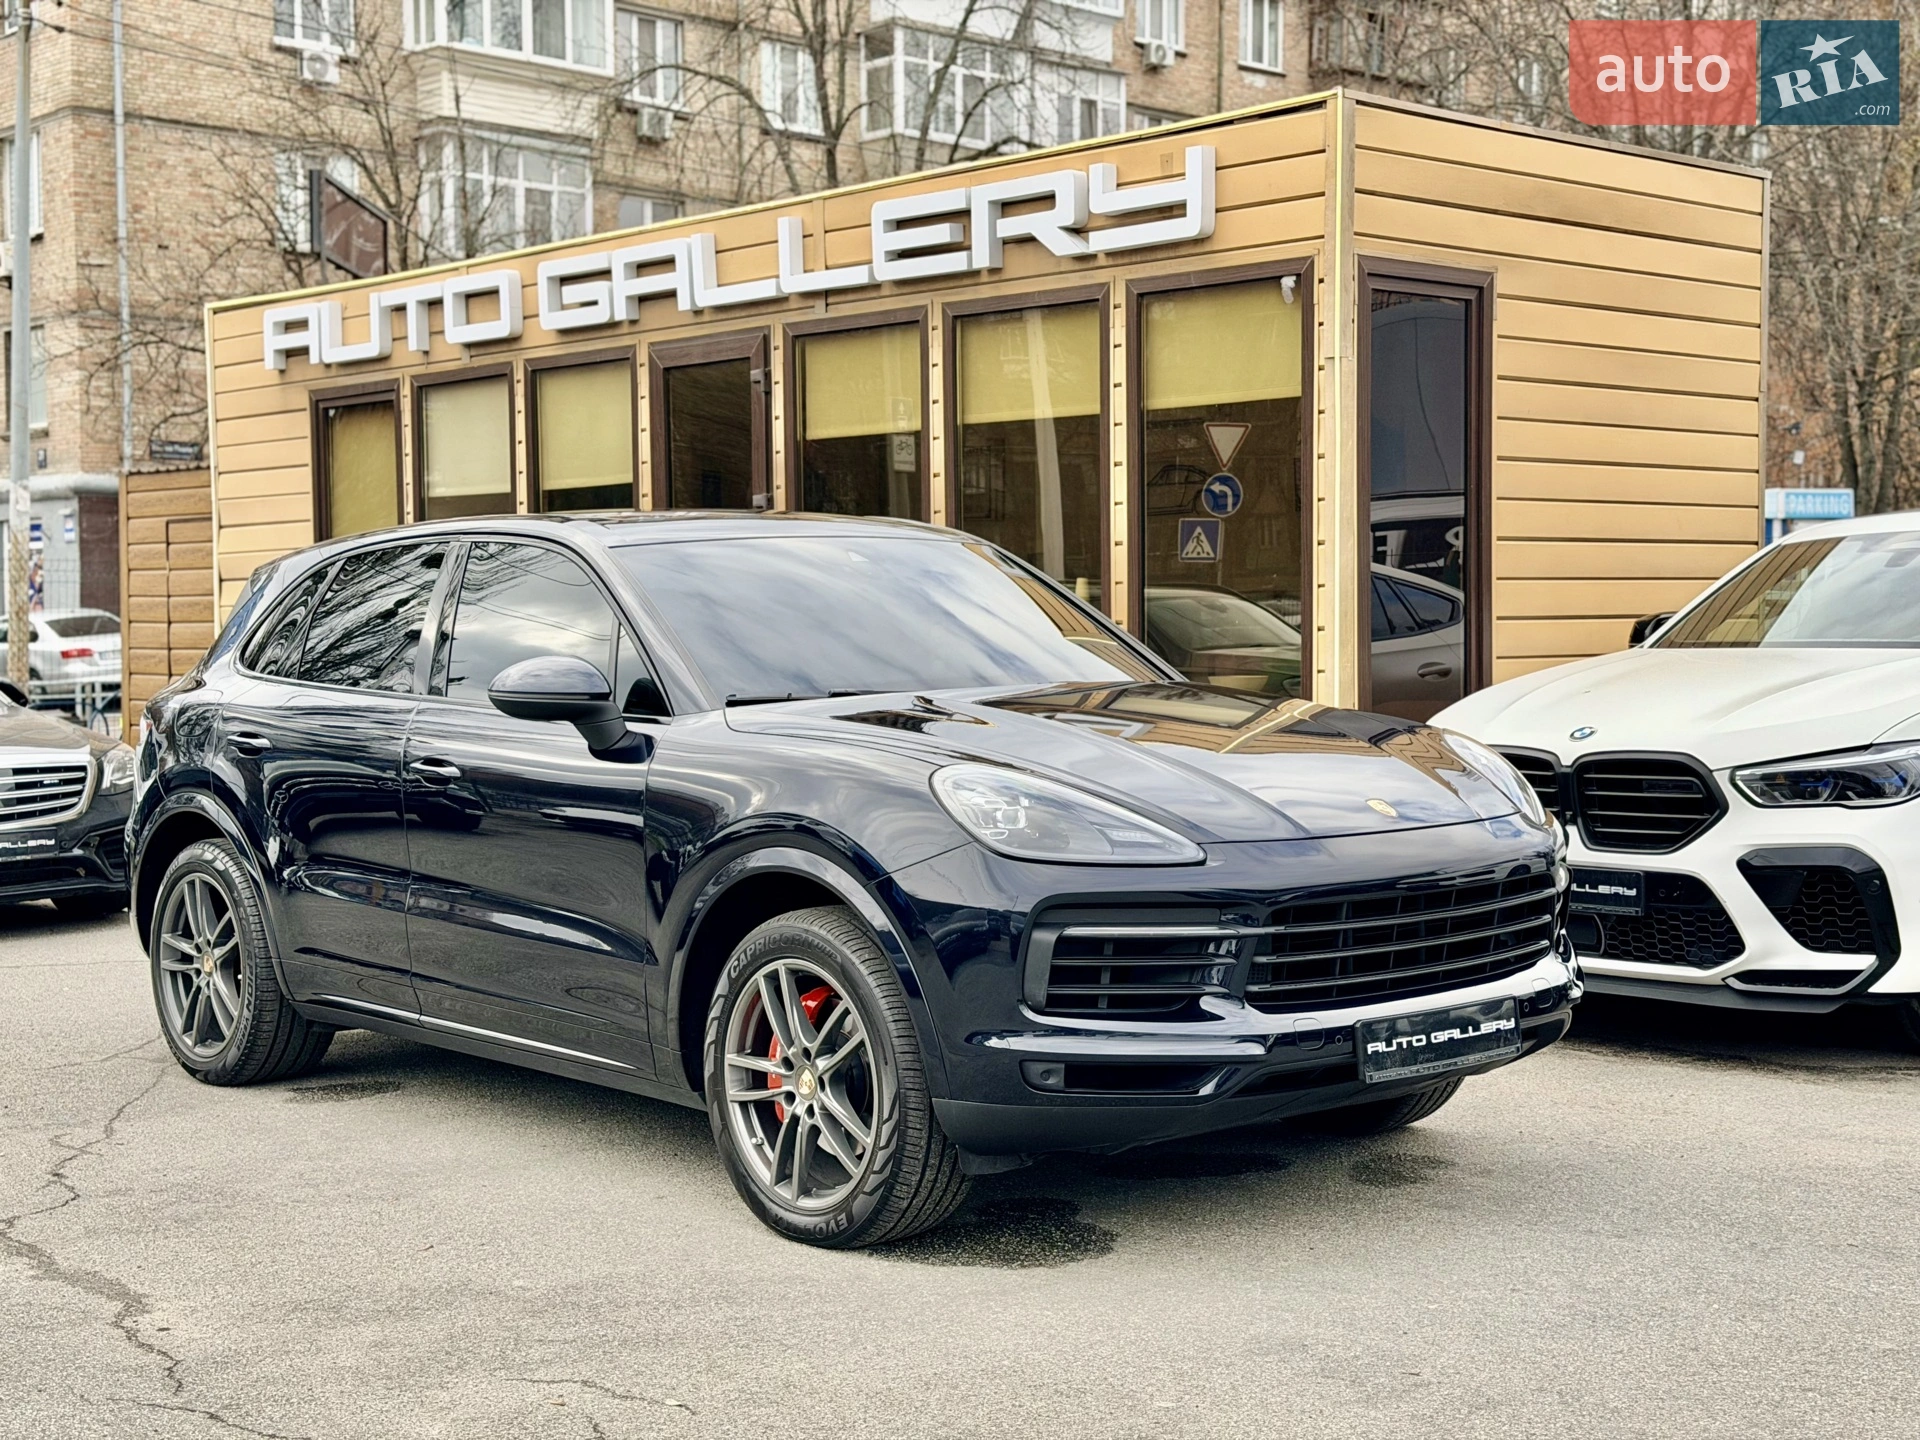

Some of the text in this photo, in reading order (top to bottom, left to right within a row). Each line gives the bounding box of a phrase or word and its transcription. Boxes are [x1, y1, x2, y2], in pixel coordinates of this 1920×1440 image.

[263, 145, 1217, 371] AUTO GALLERY
[1788, 494, 1850, 515] PARKING
[1571, 882, 1637, 897] LLERY
[729, 931, 816, 980] CAPRICORN
[1366, 1017, 1516, 1055] AUTO GALLERY
